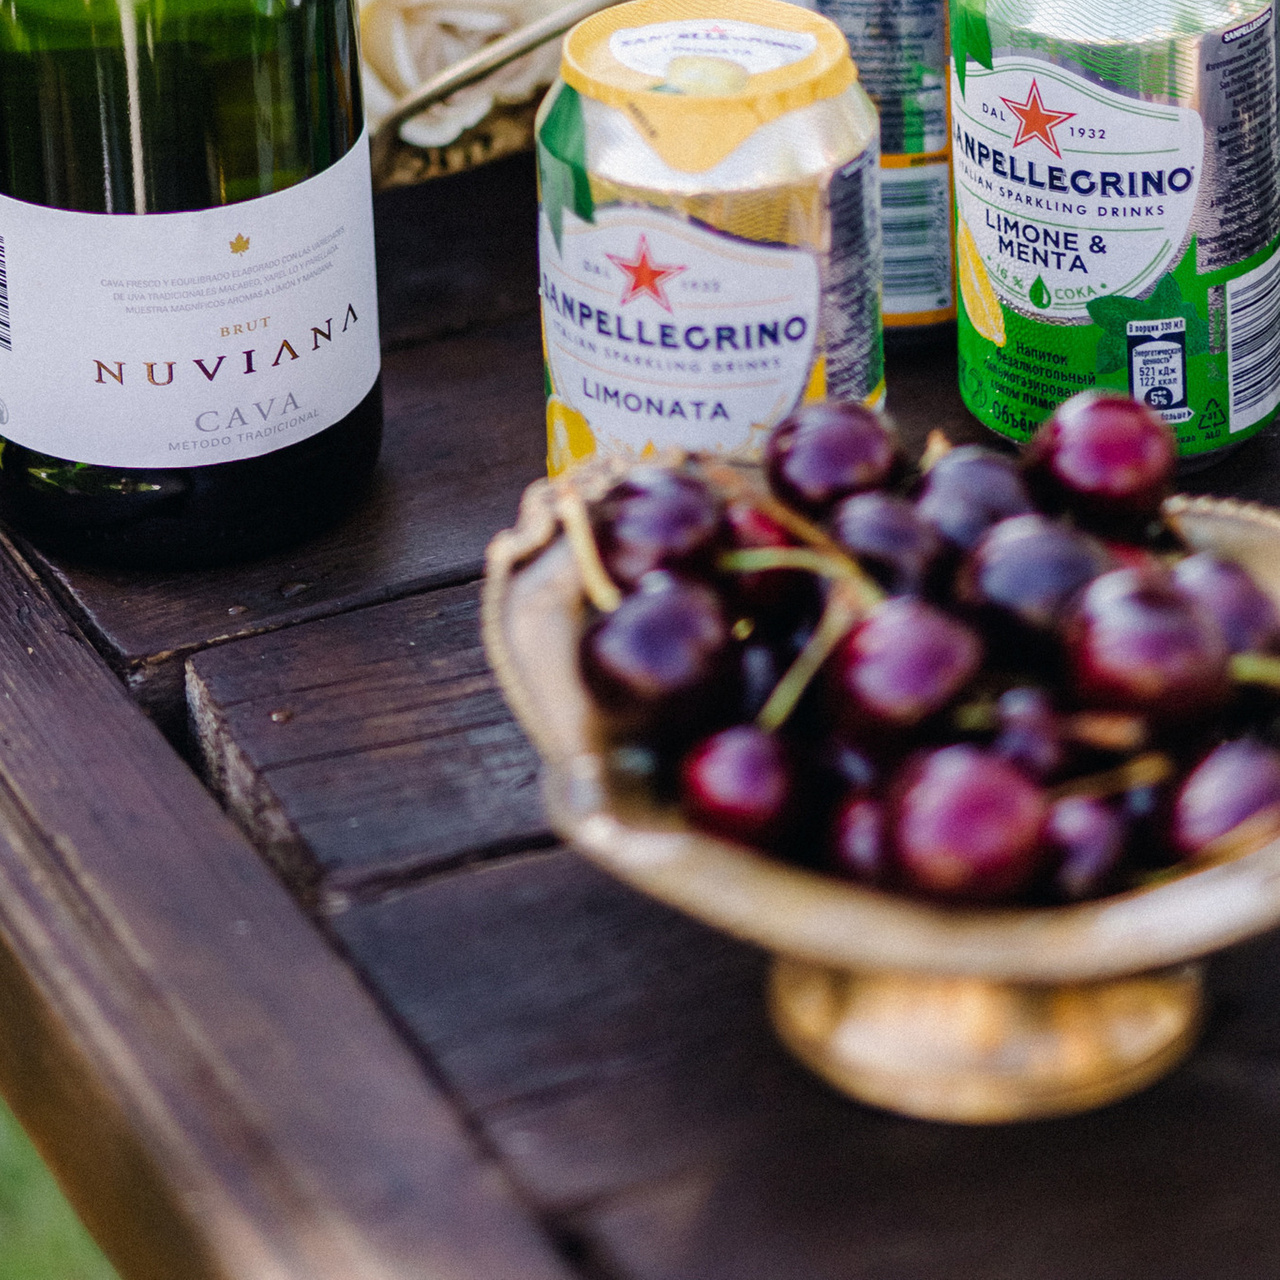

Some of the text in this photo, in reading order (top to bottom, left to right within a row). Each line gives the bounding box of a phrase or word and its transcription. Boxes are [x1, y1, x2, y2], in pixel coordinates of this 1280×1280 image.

[982, 102, 1106, 140] DAL 1932
[999, 186, 1088, 215] SPARKLING
[1097, 204, 1165, 217] DRINKS
[985, 208, 1108, 254] LIMONE &
[998, 234, 1089, 274] MENTA
[100, 278, 124, 289] CAVA
[125, 278, 162, 289] FRESCO
[124, 304, 170, 315] MUESTRA
[219, 316, 272, 337] BRUT
[93, 303, 359, 386] NUVIANA
[1016, 340, 1068, 366] Напиток
[1139, 366, 1157, 377] 521
[1139, 376, 1156, 387] 122
[194, 391, 302, 433] CAVA
[582, 376, 731, 421] LIMONATA
[236, 407, 321, 441] TRADICIONAL
